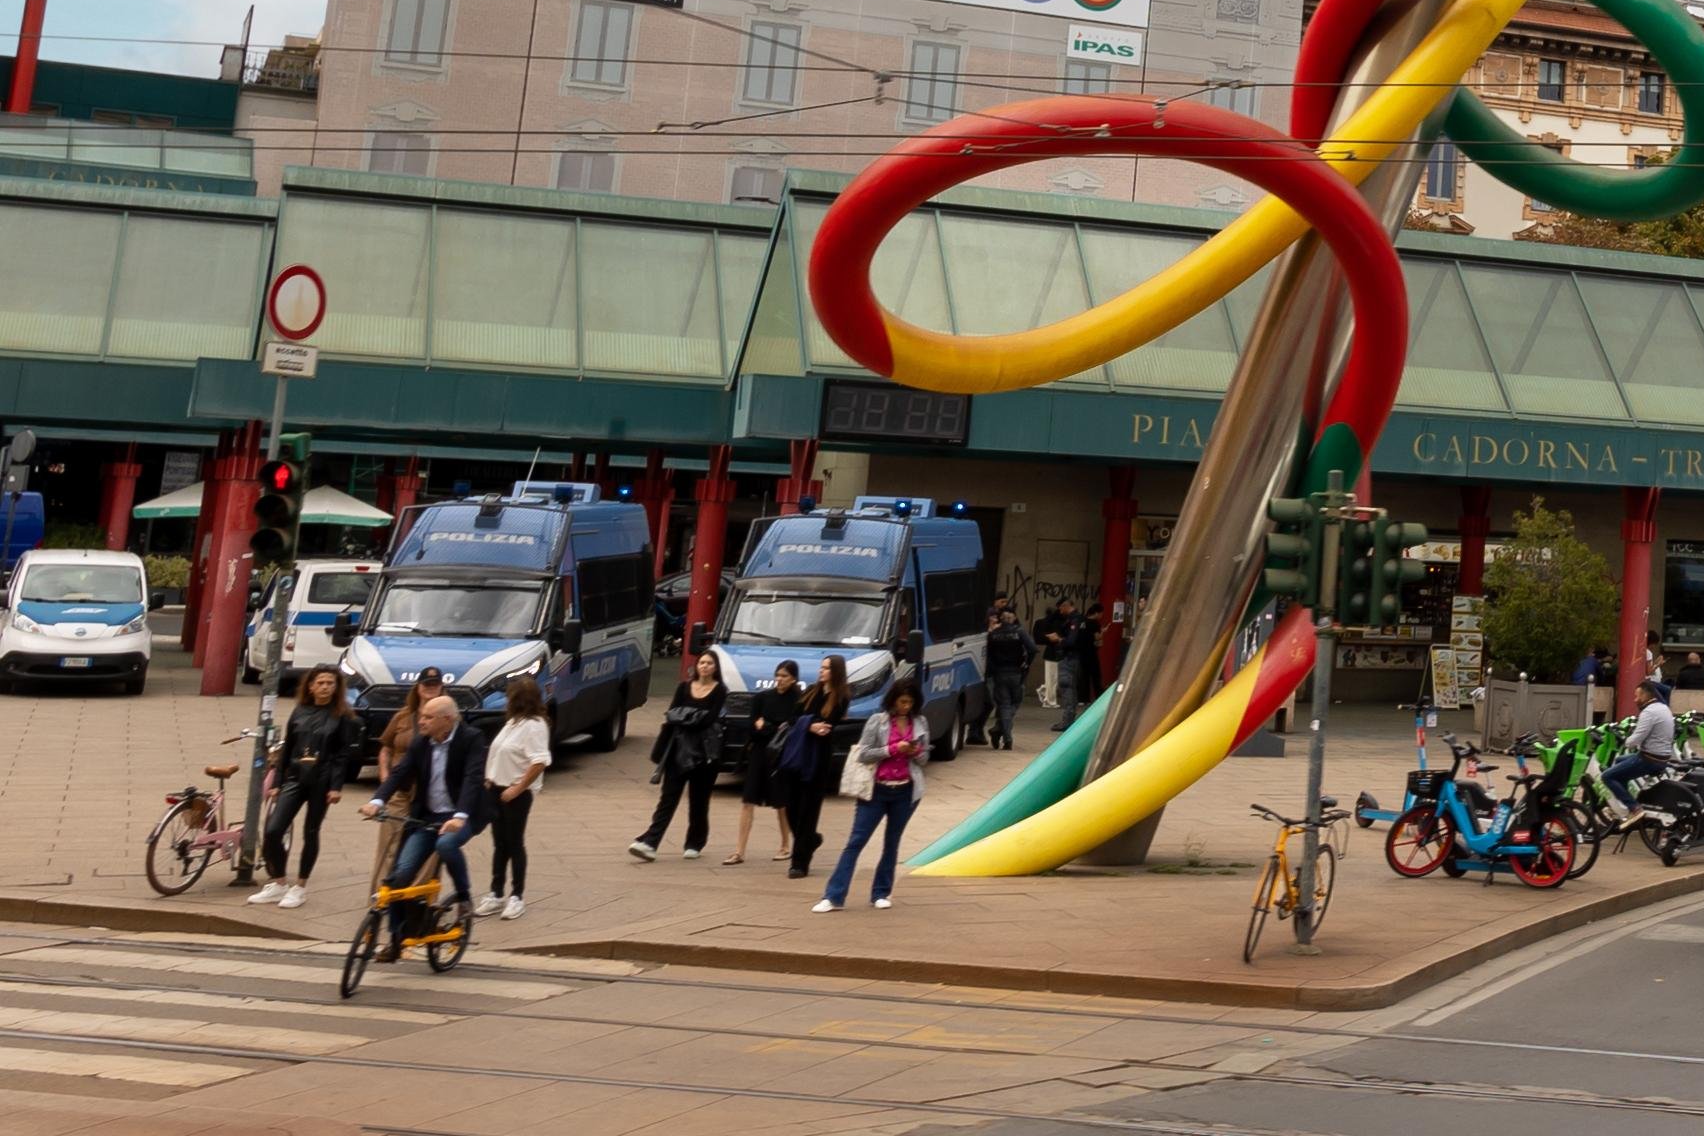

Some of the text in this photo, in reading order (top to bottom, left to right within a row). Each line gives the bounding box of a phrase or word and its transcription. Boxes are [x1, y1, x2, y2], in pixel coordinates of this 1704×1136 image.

[1074, 40, 1134, 57] IPAS
[1132, 414, 1208, 448] PIA
[1413, 432, 1618, 473] CADORNA
[428, 532, 535, 545] POLIZIA
[779, 544, 879, 558] POLIZIA
[582, 655, 617, 681] POLIZIA
